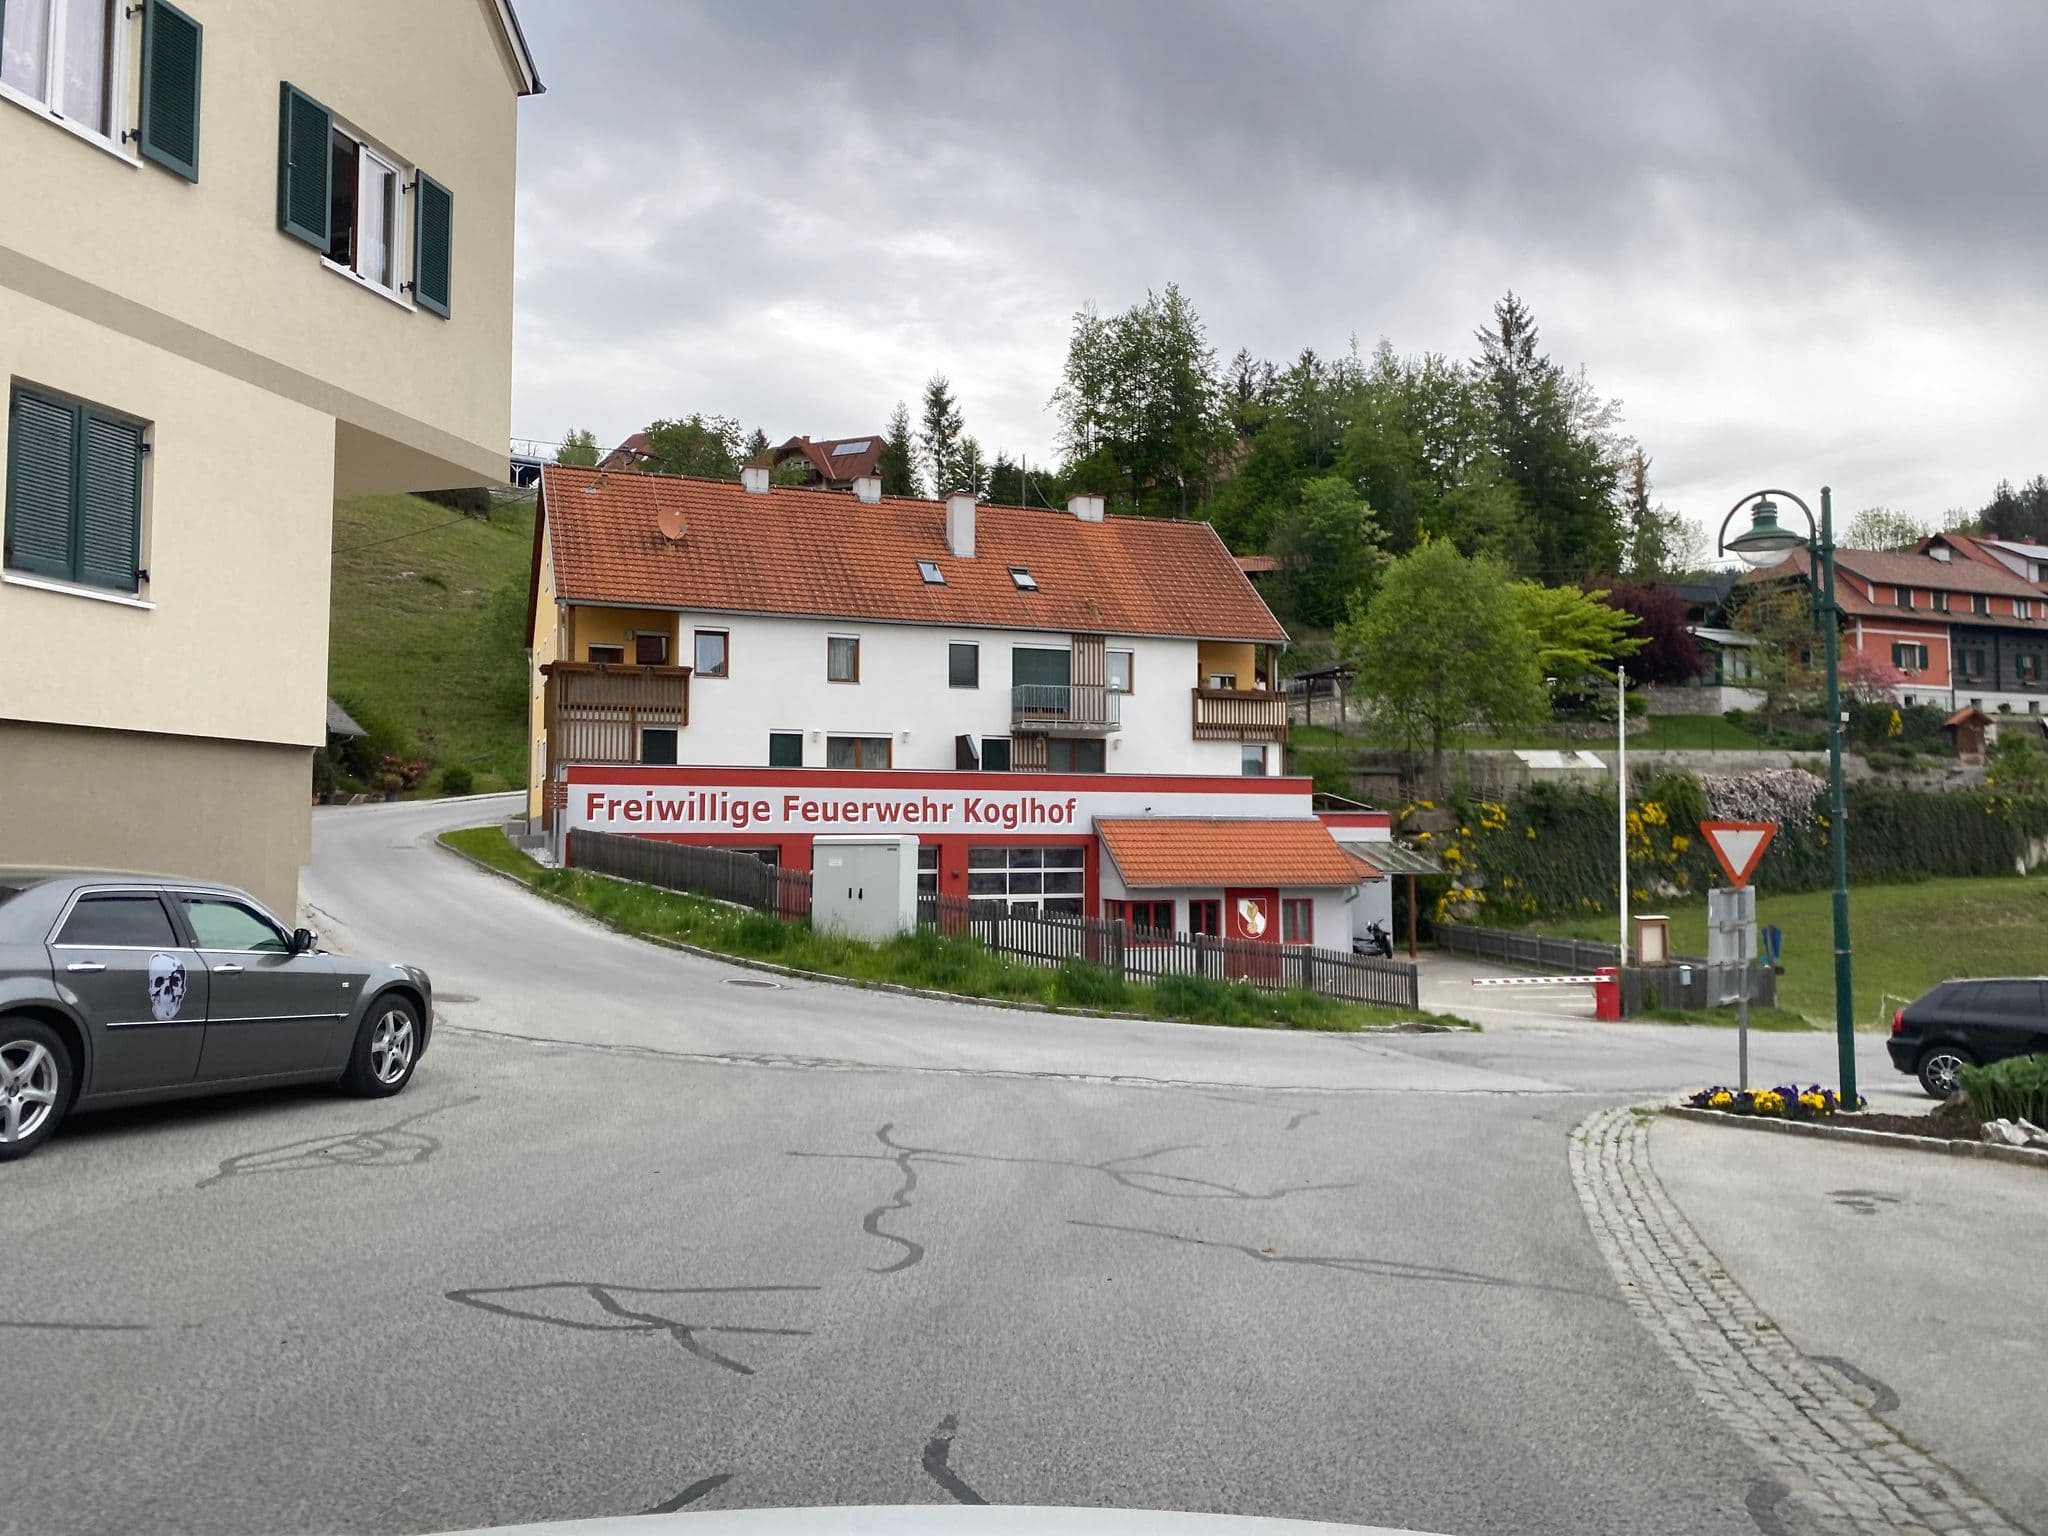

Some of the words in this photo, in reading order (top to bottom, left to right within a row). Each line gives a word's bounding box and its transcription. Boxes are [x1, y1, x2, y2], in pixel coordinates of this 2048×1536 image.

[586, 790, 771, 829] Freiwillige
[783, 795, 954, 824] Feuerwehr
[963, 798, 1077, 831] Koglhof
